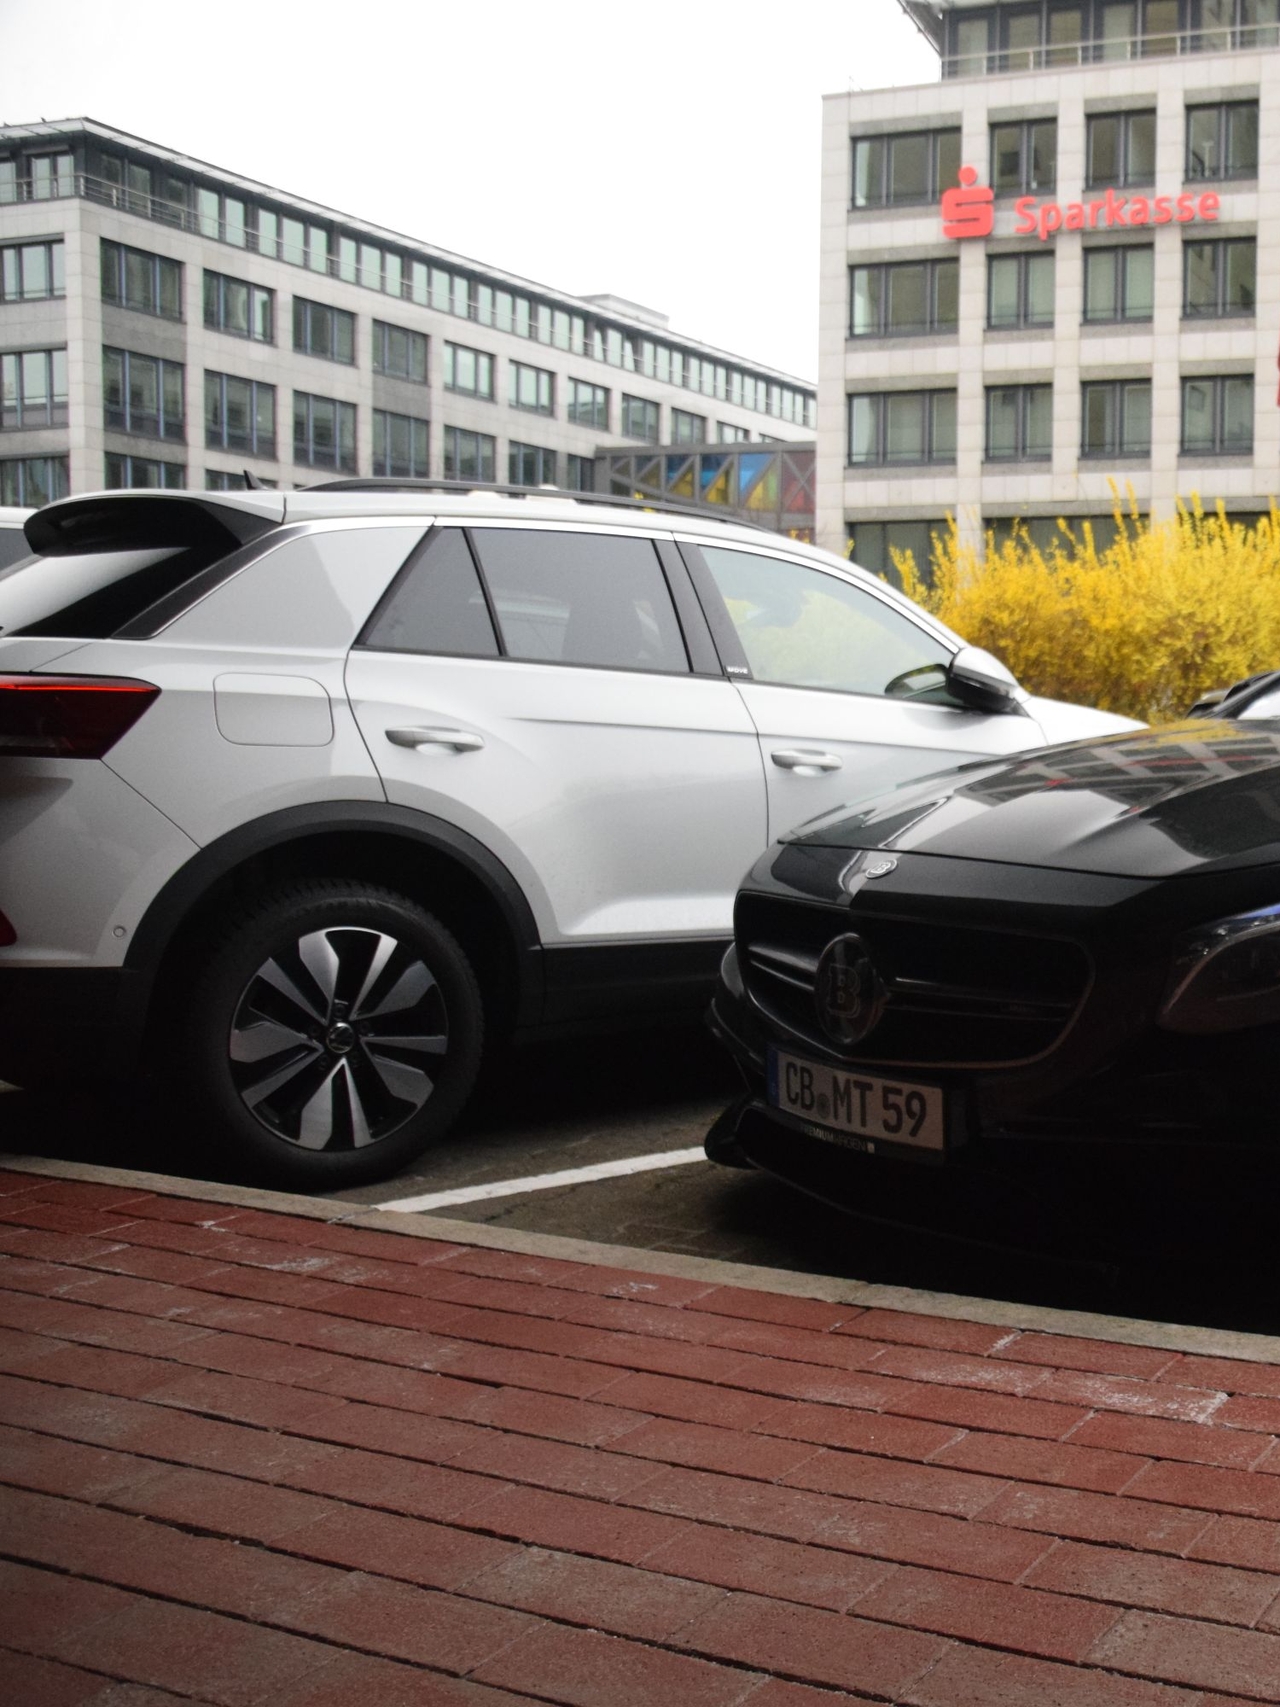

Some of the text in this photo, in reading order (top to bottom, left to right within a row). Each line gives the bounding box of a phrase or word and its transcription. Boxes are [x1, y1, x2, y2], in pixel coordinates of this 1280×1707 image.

[1015, 187, 1221, 241] Sparkasse
[786, 1062, 927, 1138] CB MT 59
